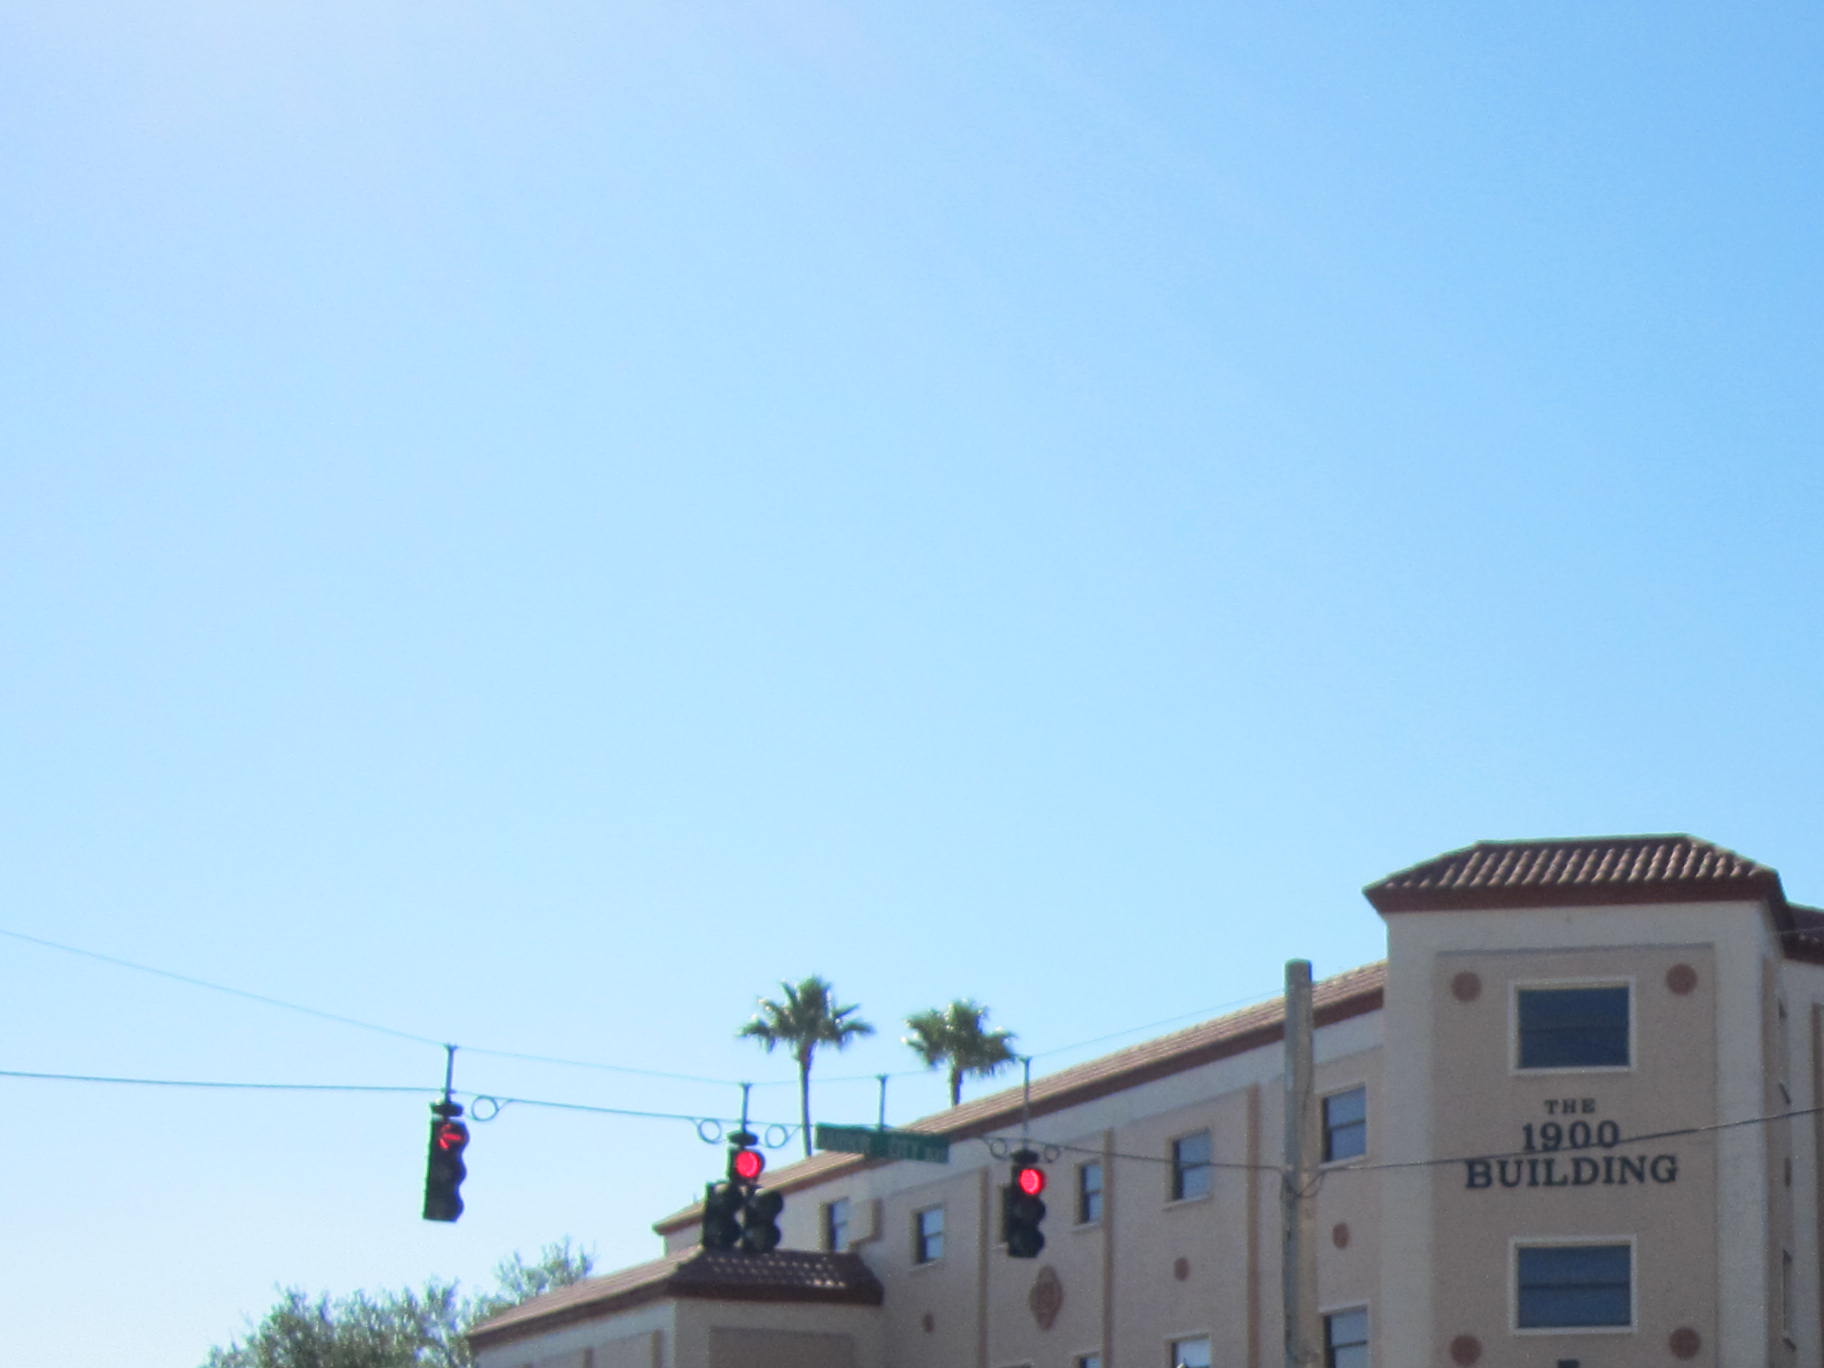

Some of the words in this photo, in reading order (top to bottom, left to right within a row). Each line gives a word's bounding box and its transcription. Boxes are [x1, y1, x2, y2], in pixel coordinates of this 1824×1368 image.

[1545, 1099, 1596, 1114] THE
[1523, 1120, 1620, 1151] 1900
[1465, 1155, 1678, 1189] BUILDING
